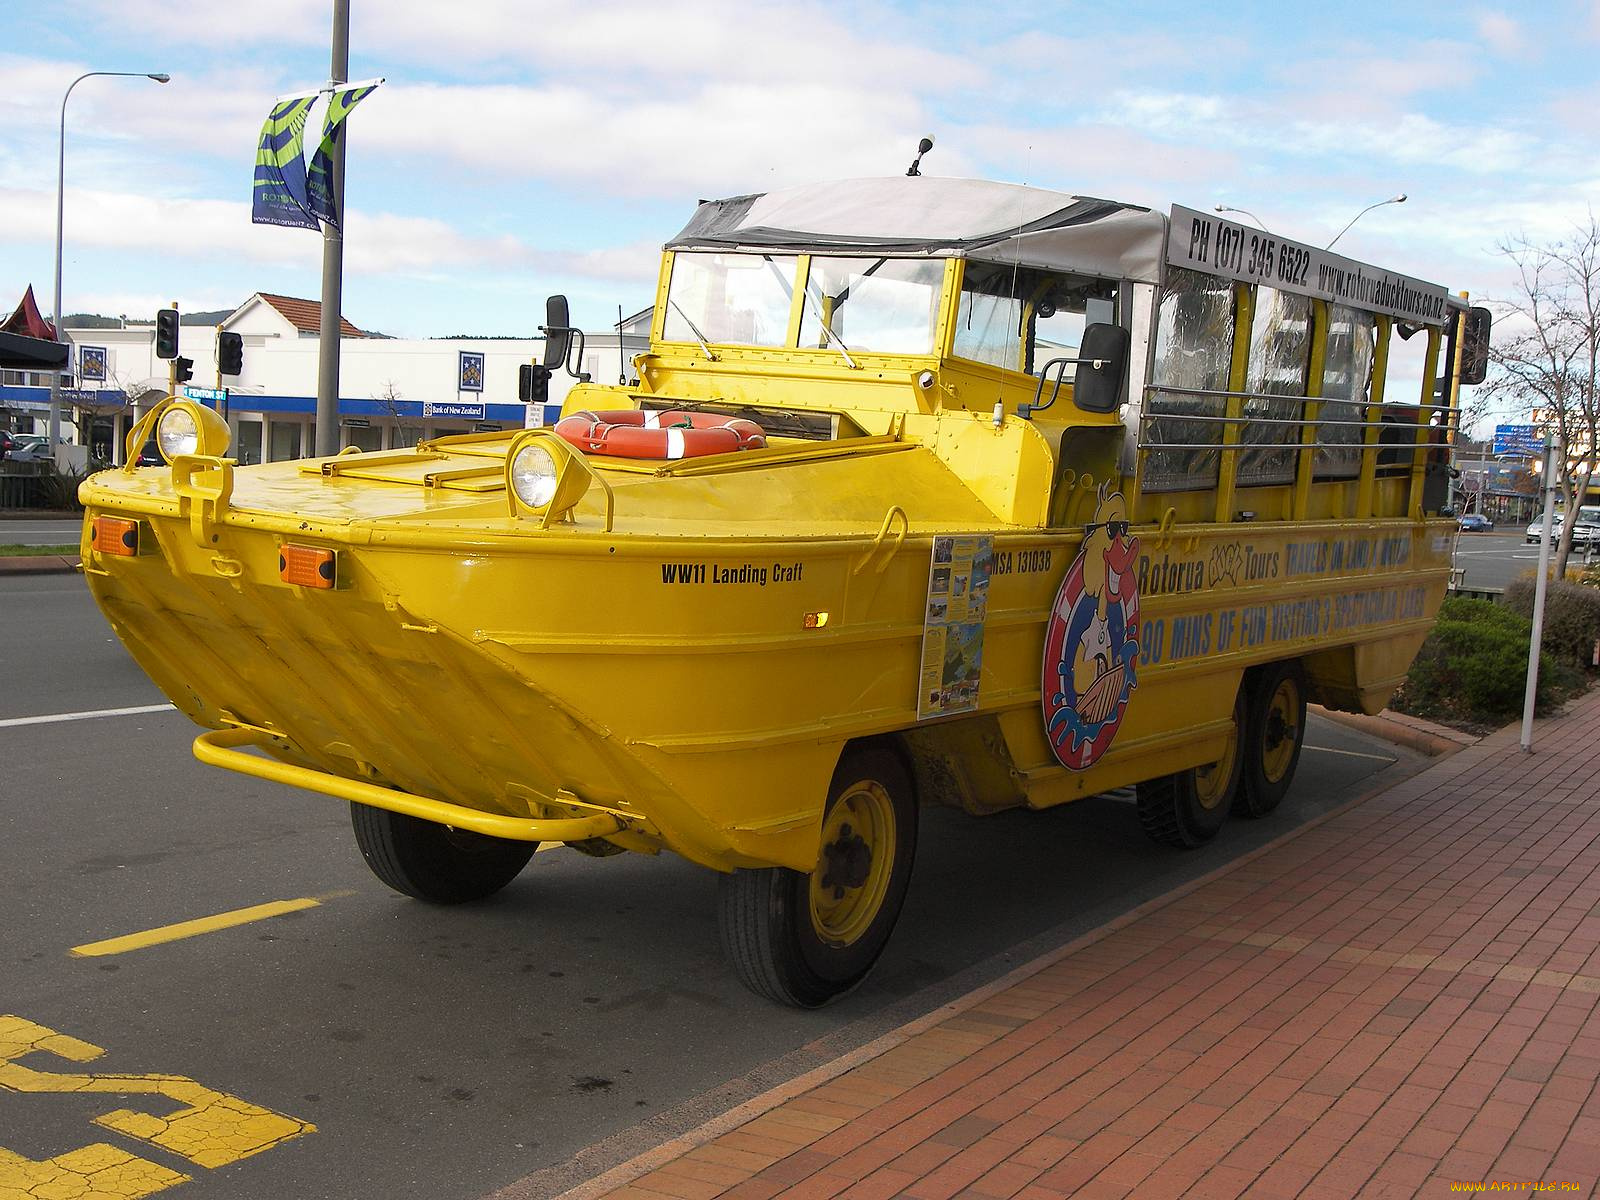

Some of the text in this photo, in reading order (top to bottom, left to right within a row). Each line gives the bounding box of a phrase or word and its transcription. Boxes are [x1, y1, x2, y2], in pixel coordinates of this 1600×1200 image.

[1188, 217, 1445, 320] PH (07) 345 6522 www.rotoruaducktours.co.nz
[188, 388, 223, 400] FENTON ST
[432, 405, 482, 415] Bank of New Zealand
[1017, 550, 1052, 573] 131038
[1138, 553, 1205, 596] Rotorua
[1245, 544, 1280, 581] Tours
[661, 562, 803, 586] WW11 Landing Craft
[1140, 618, 1165, 666] 90
[1169, 611, 1213, 661] MINS
[1217, 609, 1237, 653] OF
[1239, 605, 1268, 648] FUN
[1271, 597, 1321, 641] VISITING
[1322, 595, 1331, 633] 3
